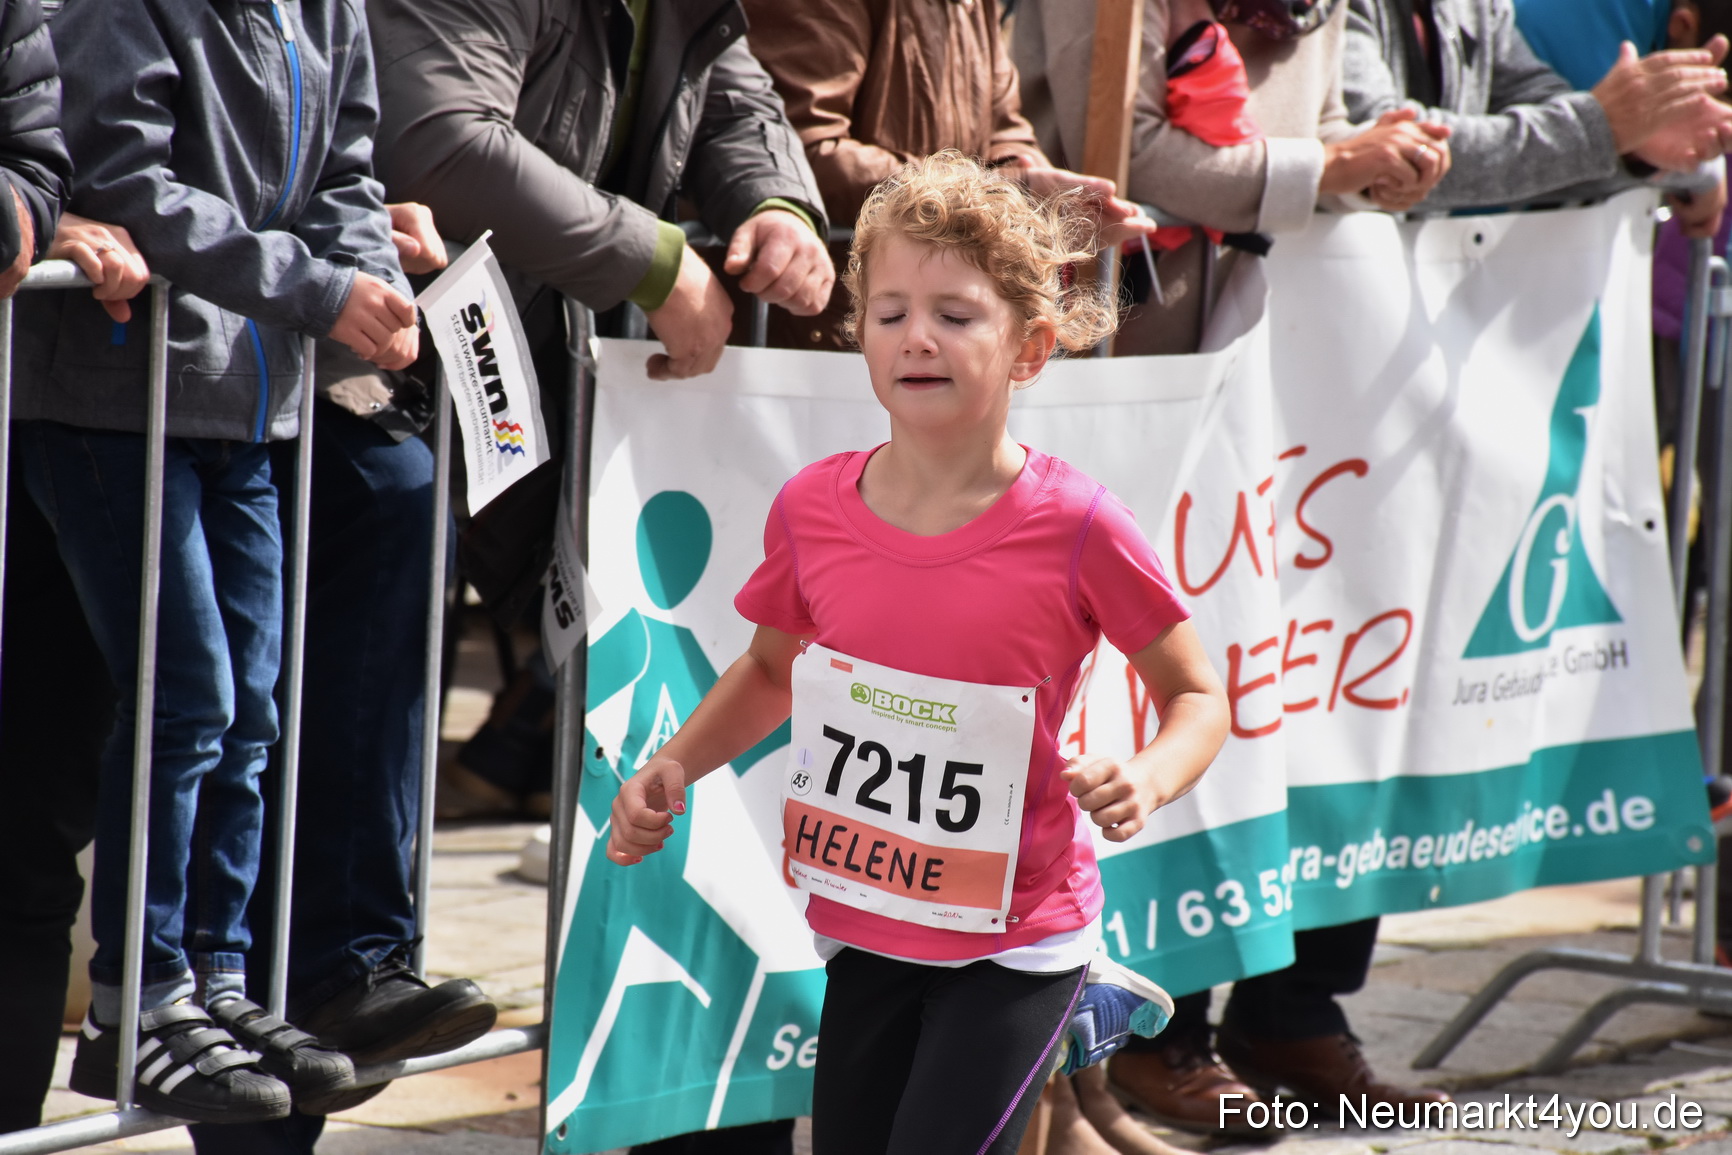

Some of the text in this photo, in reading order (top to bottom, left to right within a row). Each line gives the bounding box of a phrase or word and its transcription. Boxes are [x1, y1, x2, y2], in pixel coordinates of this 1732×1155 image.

[450, 313, 495, 456] stadtwerke neumarkt
[460, 302, 509, 415] swn
[872, 688, 958, 726] BOCK
[1452, 677, 1488, 706] Jura
[1563, 640, 1629, 676] GmbH
[871, 708, 899, 721] inspired
[905, 717, 924, 729] smart
[925, 722, 957, 733] concepts
[823, 724, 984, 833] 7215
[795, 814, 945, 892] HELENE
